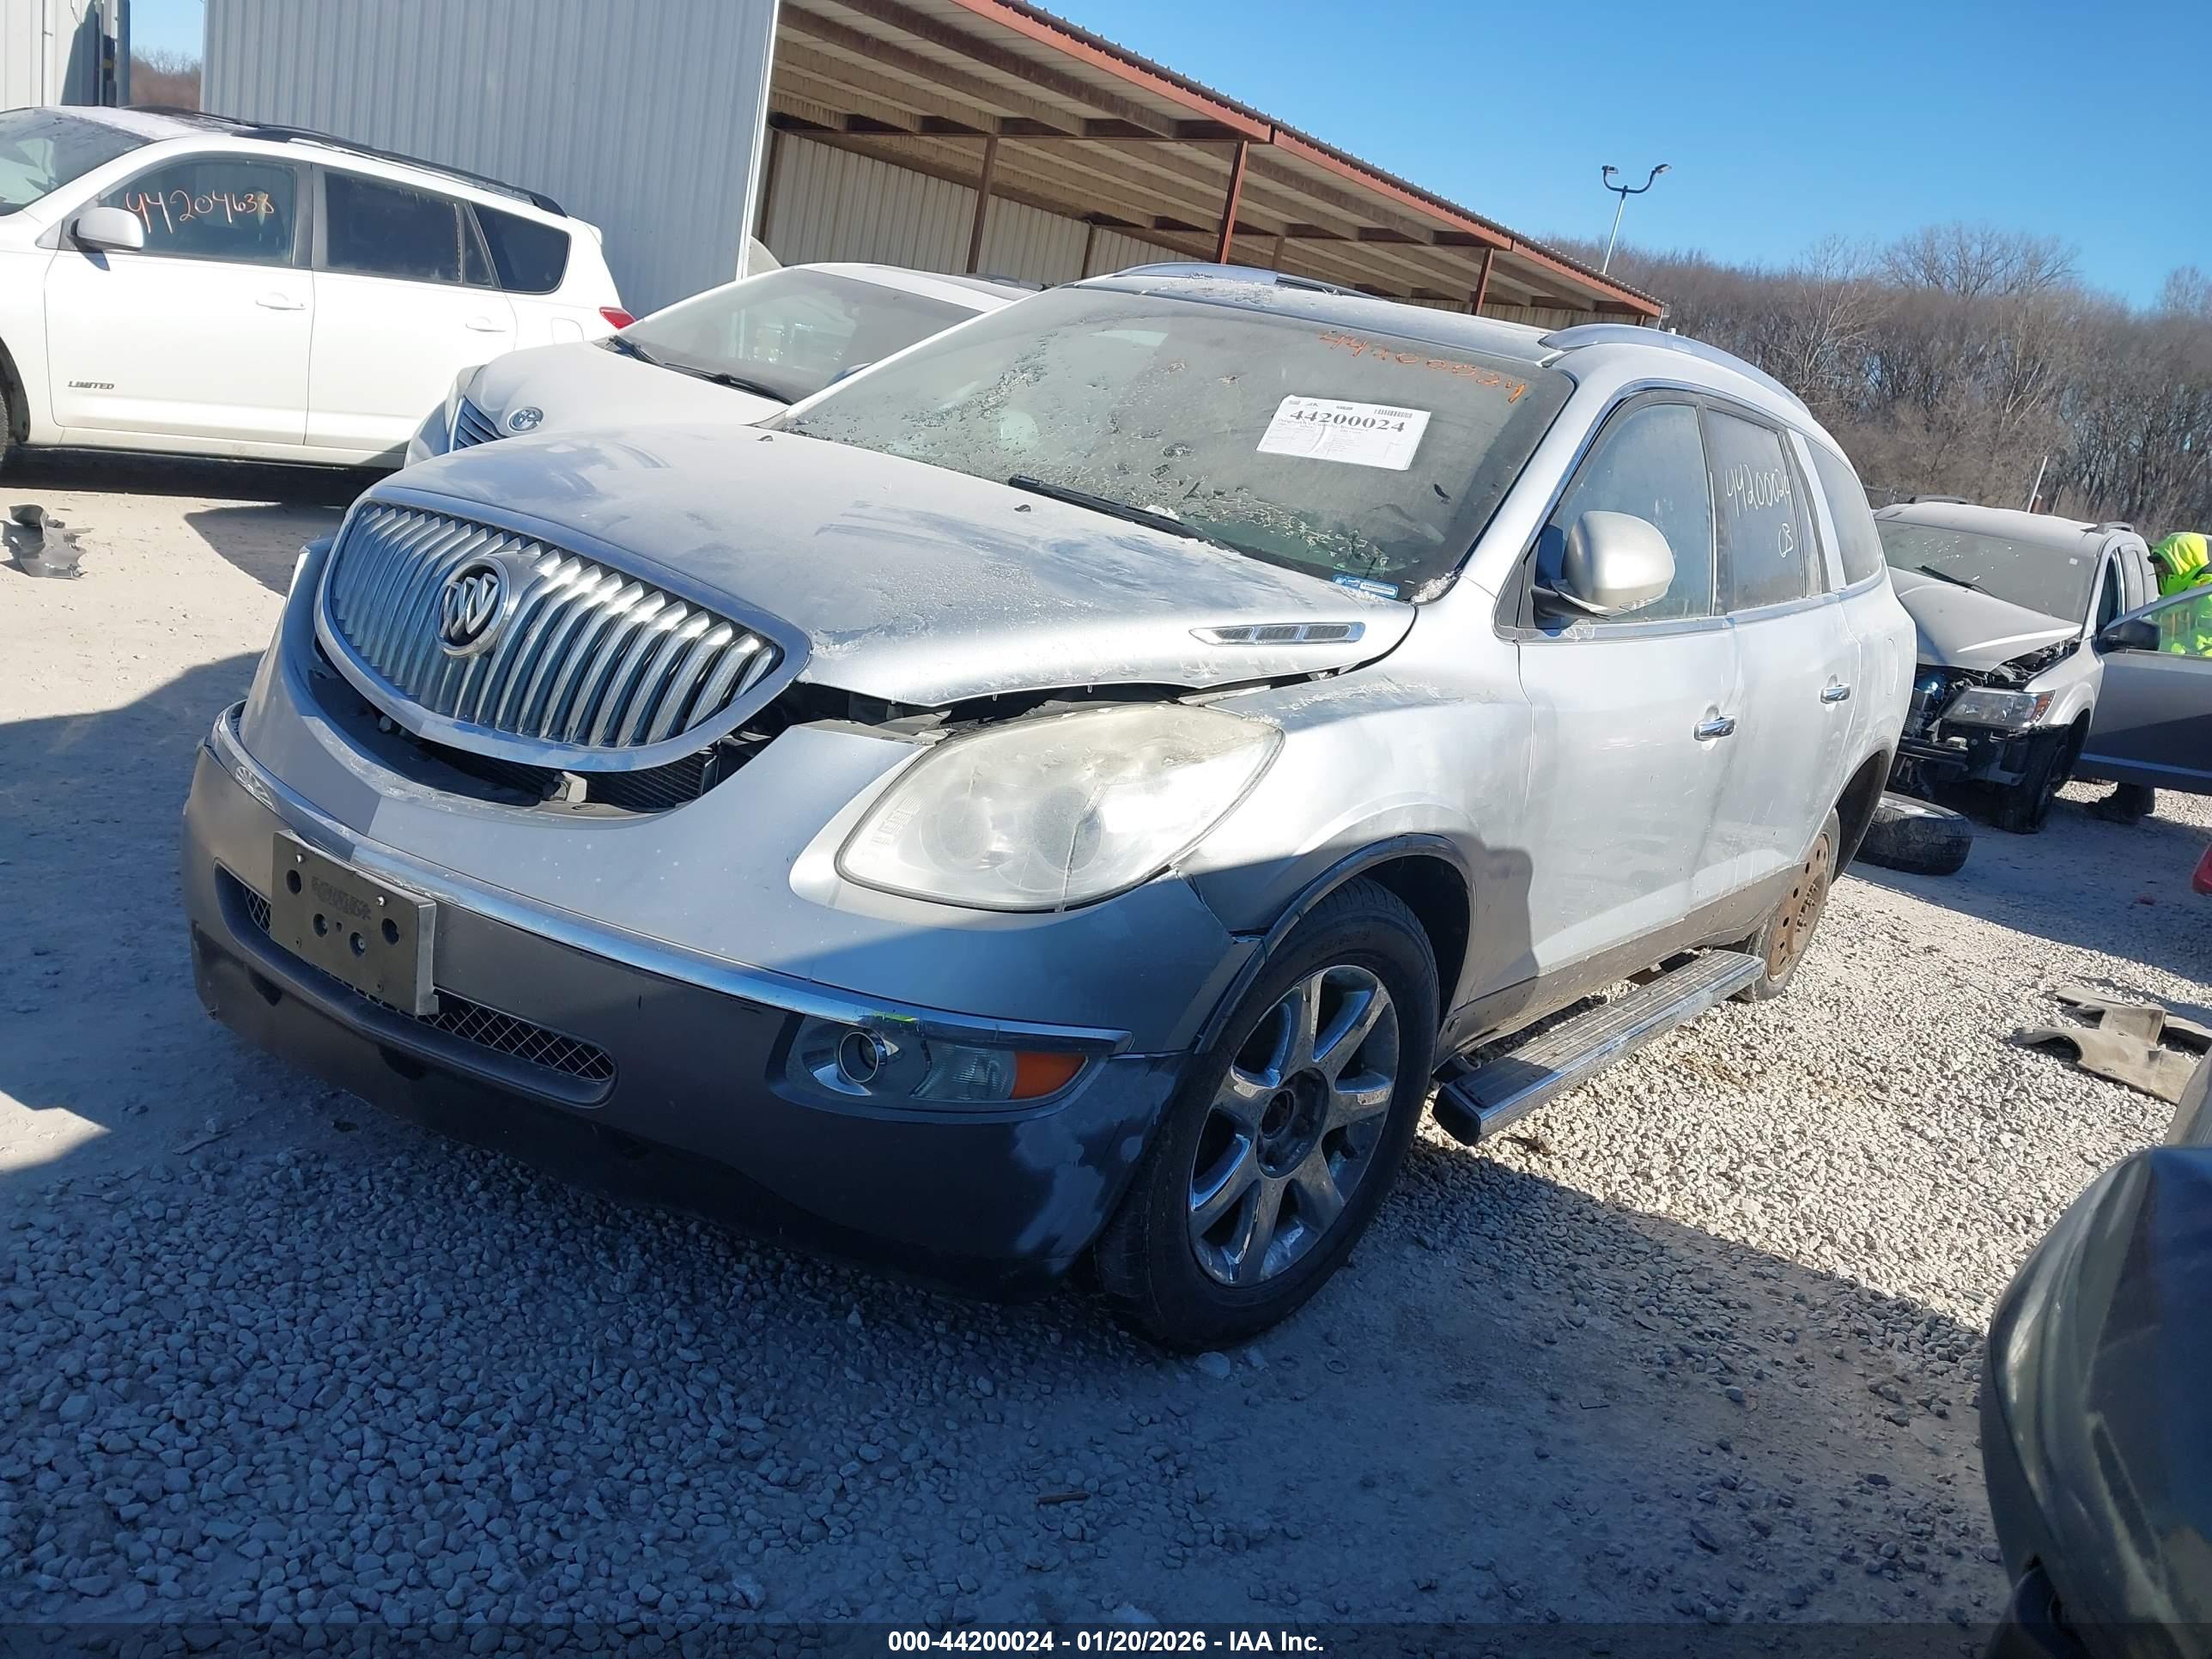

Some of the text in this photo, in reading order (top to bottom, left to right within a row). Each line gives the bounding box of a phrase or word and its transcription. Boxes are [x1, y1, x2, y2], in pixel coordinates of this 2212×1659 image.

[125, 189, 275, 234] 44204638
[68, 380, 115, 390] LIMITED
[1290, 410, 1406, 433] 44200024
